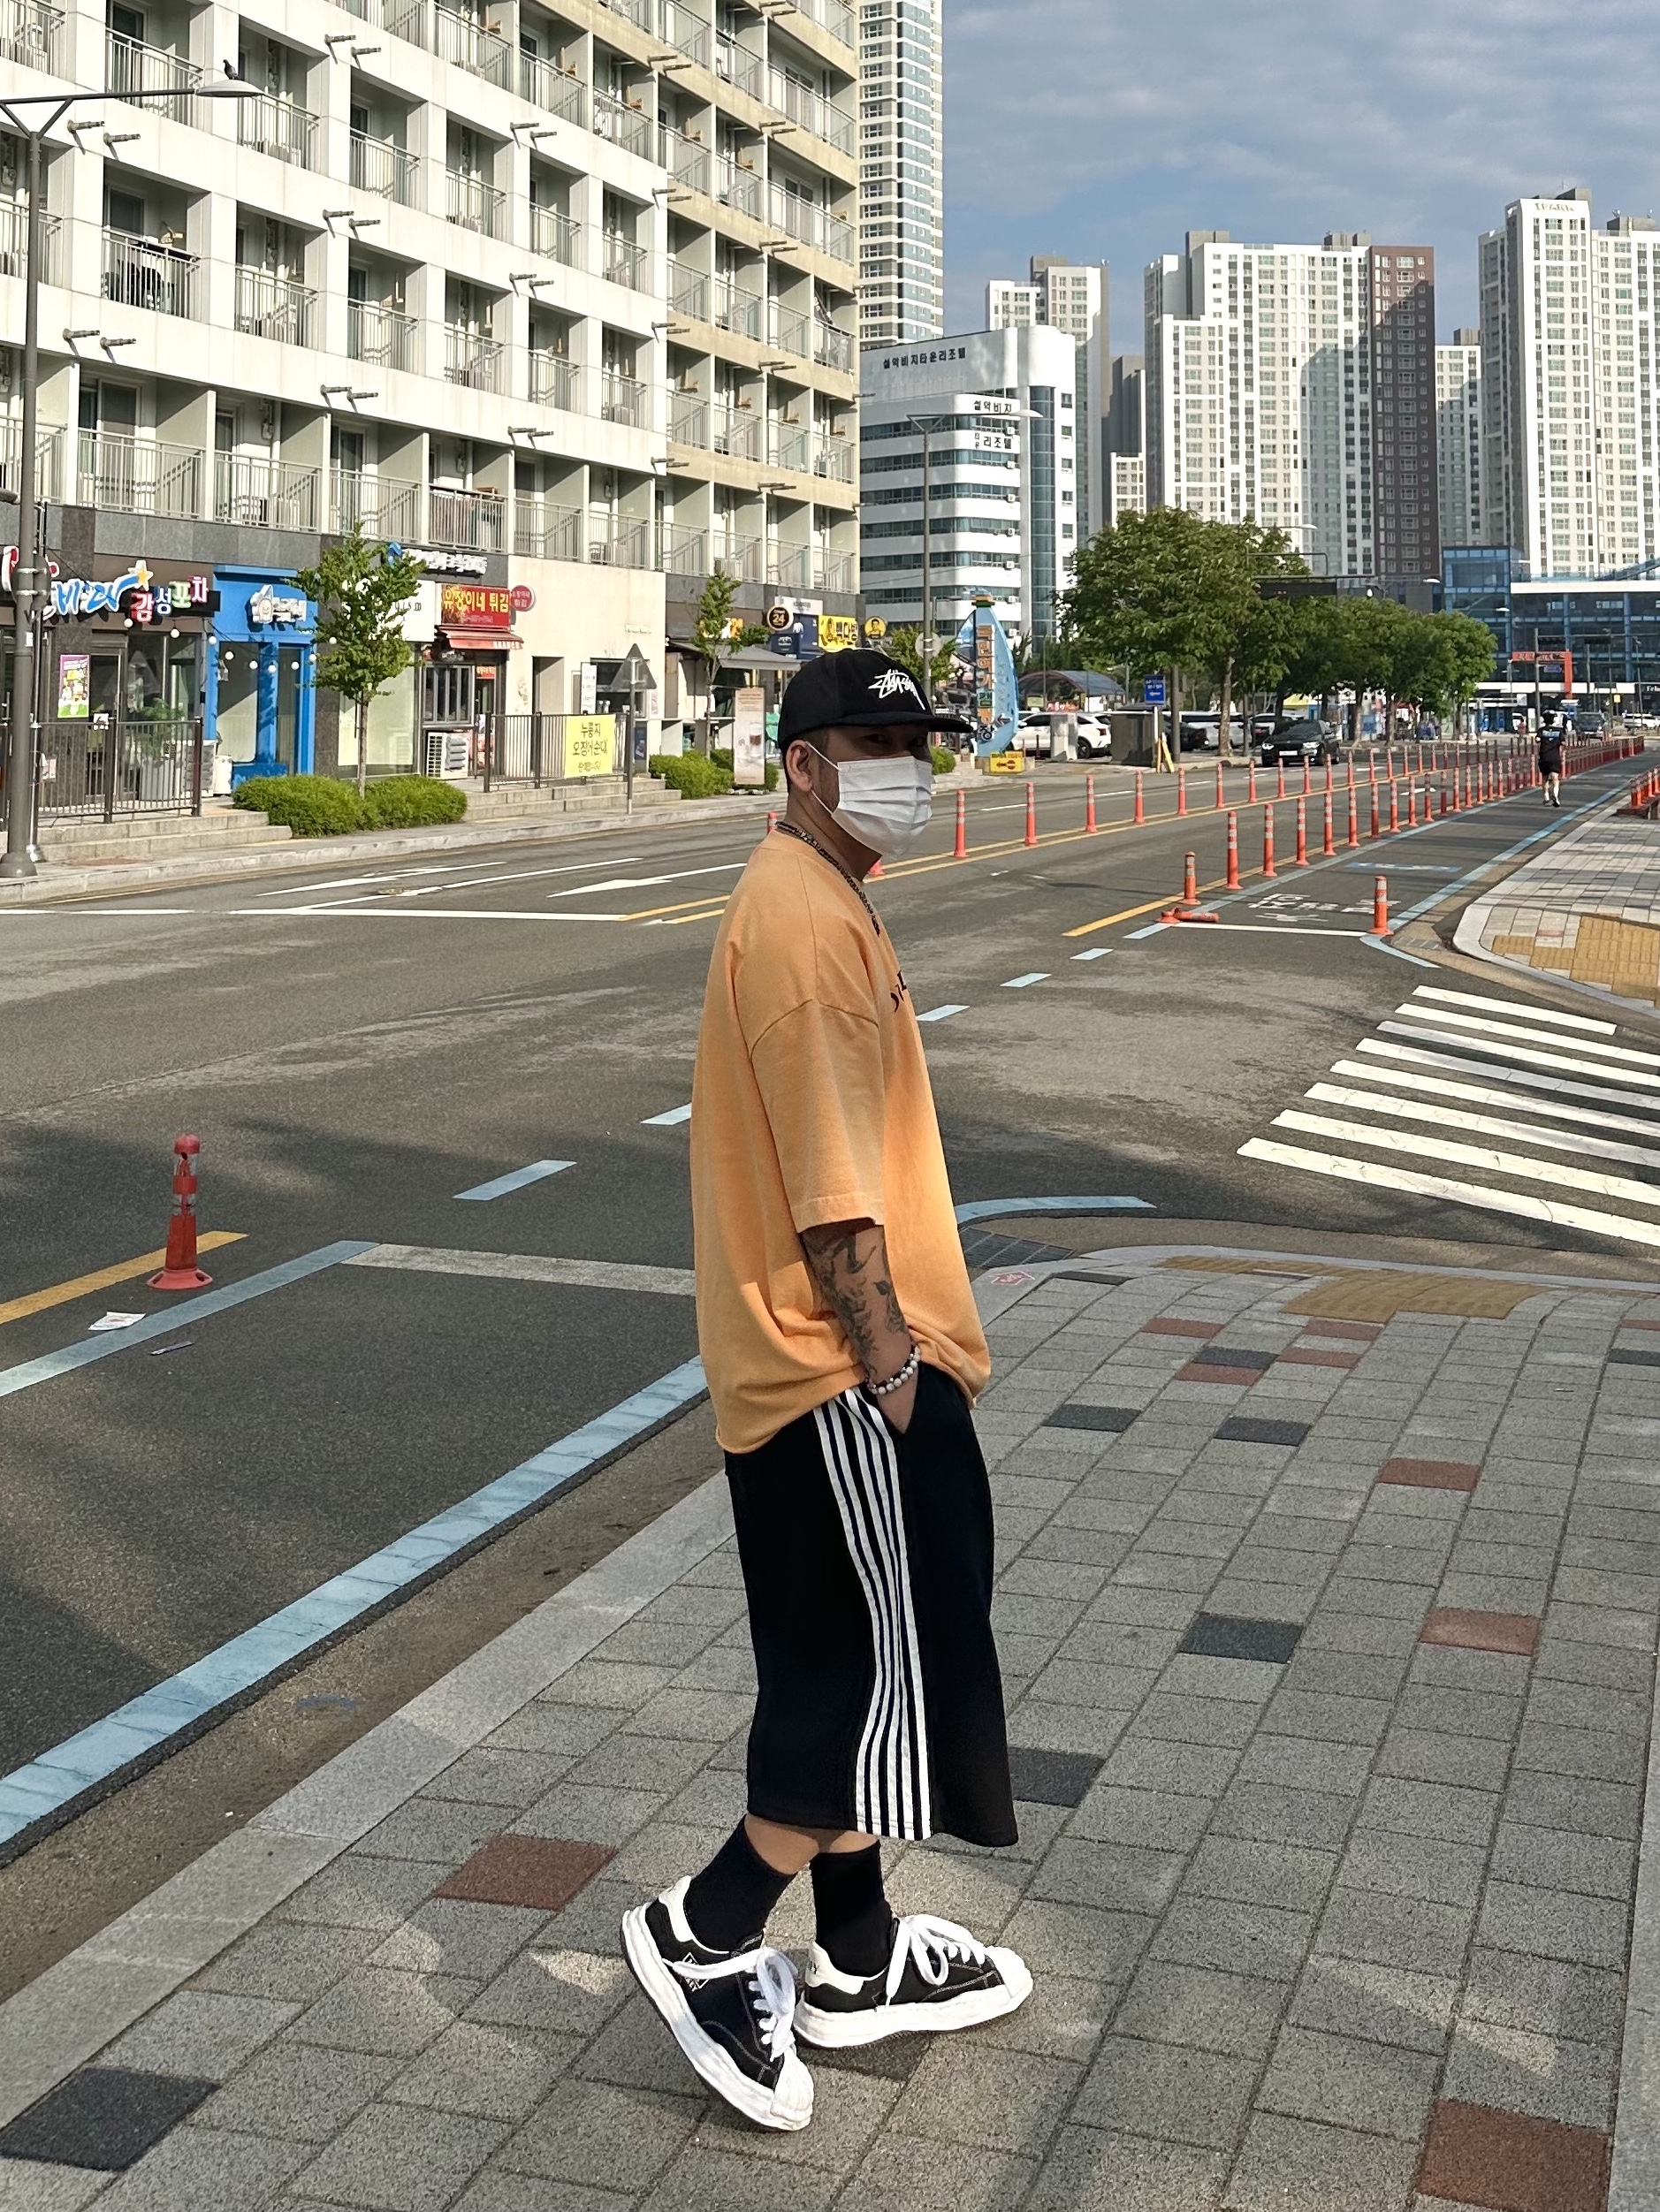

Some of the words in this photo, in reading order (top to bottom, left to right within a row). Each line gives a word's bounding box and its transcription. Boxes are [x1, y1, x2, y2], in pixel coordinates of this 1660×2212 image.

[129, 576, 209, 623] 감성포차
[489, 591, 509, 612] 튀김
[772, 613, 786, 623] 24
[581, 722, 601, 739] 누룽지
[572, 740, 608, 756] 오징어순대
